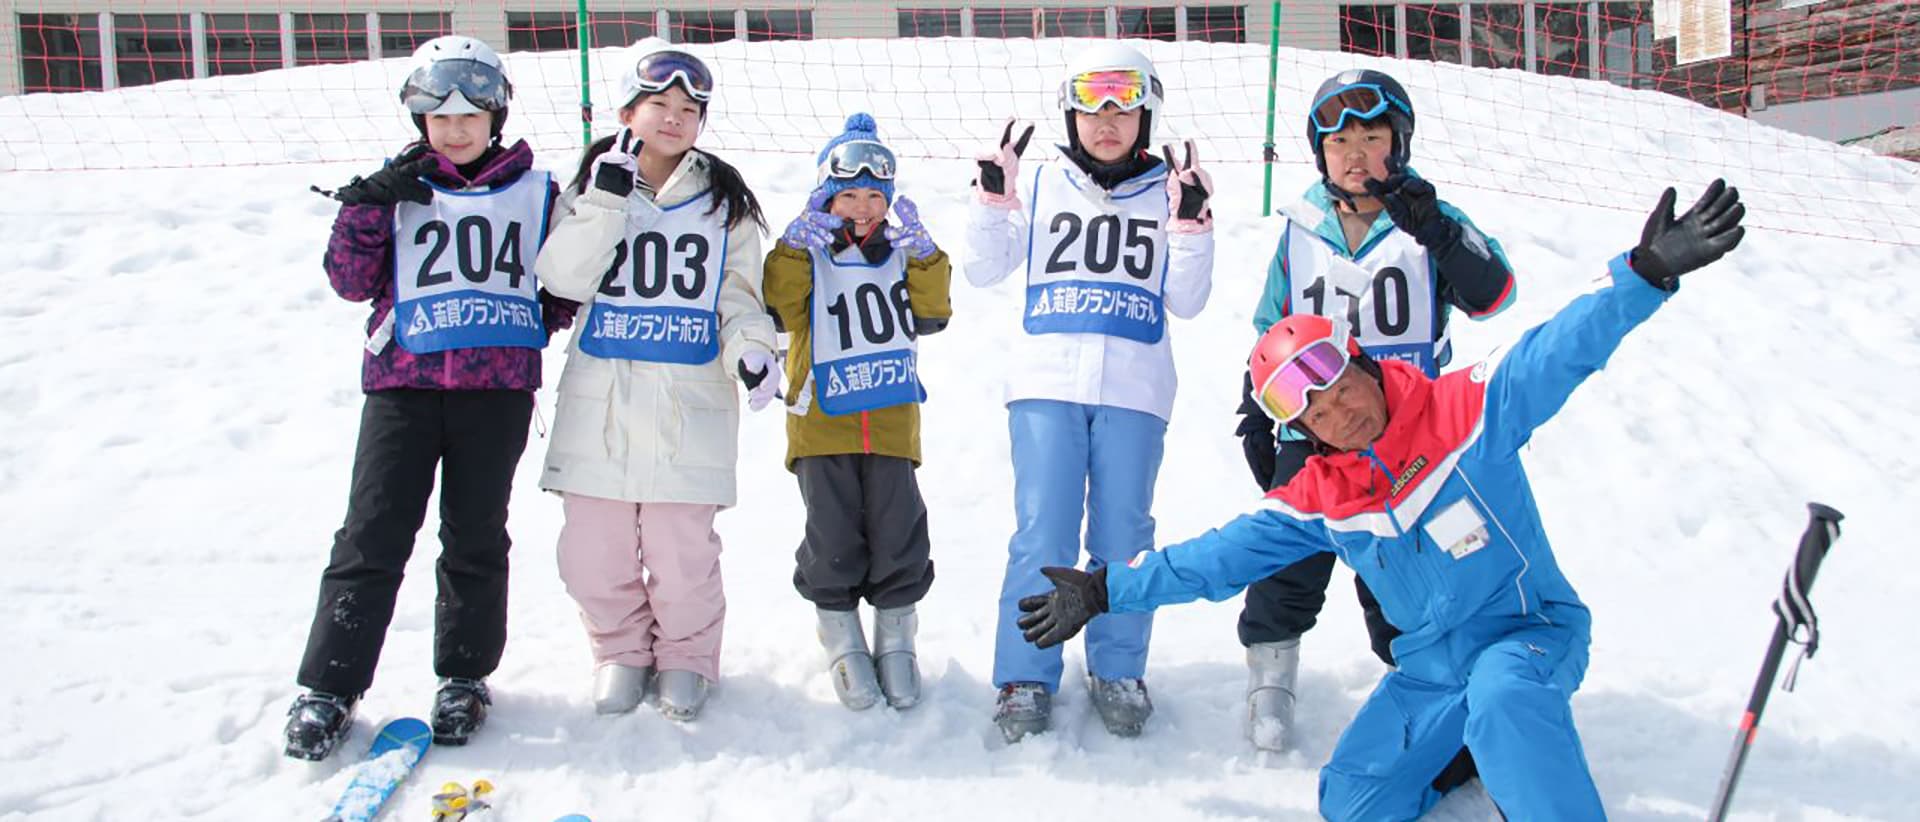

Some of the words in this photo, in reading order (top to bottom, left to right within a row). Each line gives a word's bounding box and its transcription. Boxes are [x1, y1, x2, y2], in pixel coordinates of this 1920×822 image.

[414, 215, 525, 288] 204
[597, 231, 709, 300] 203
[1045, 211, 1158, 280] 205
[601, 310, 711, 345] 志賀グランドホテル
[1052, 287, 1158, 325] 志賀グランドホテル
